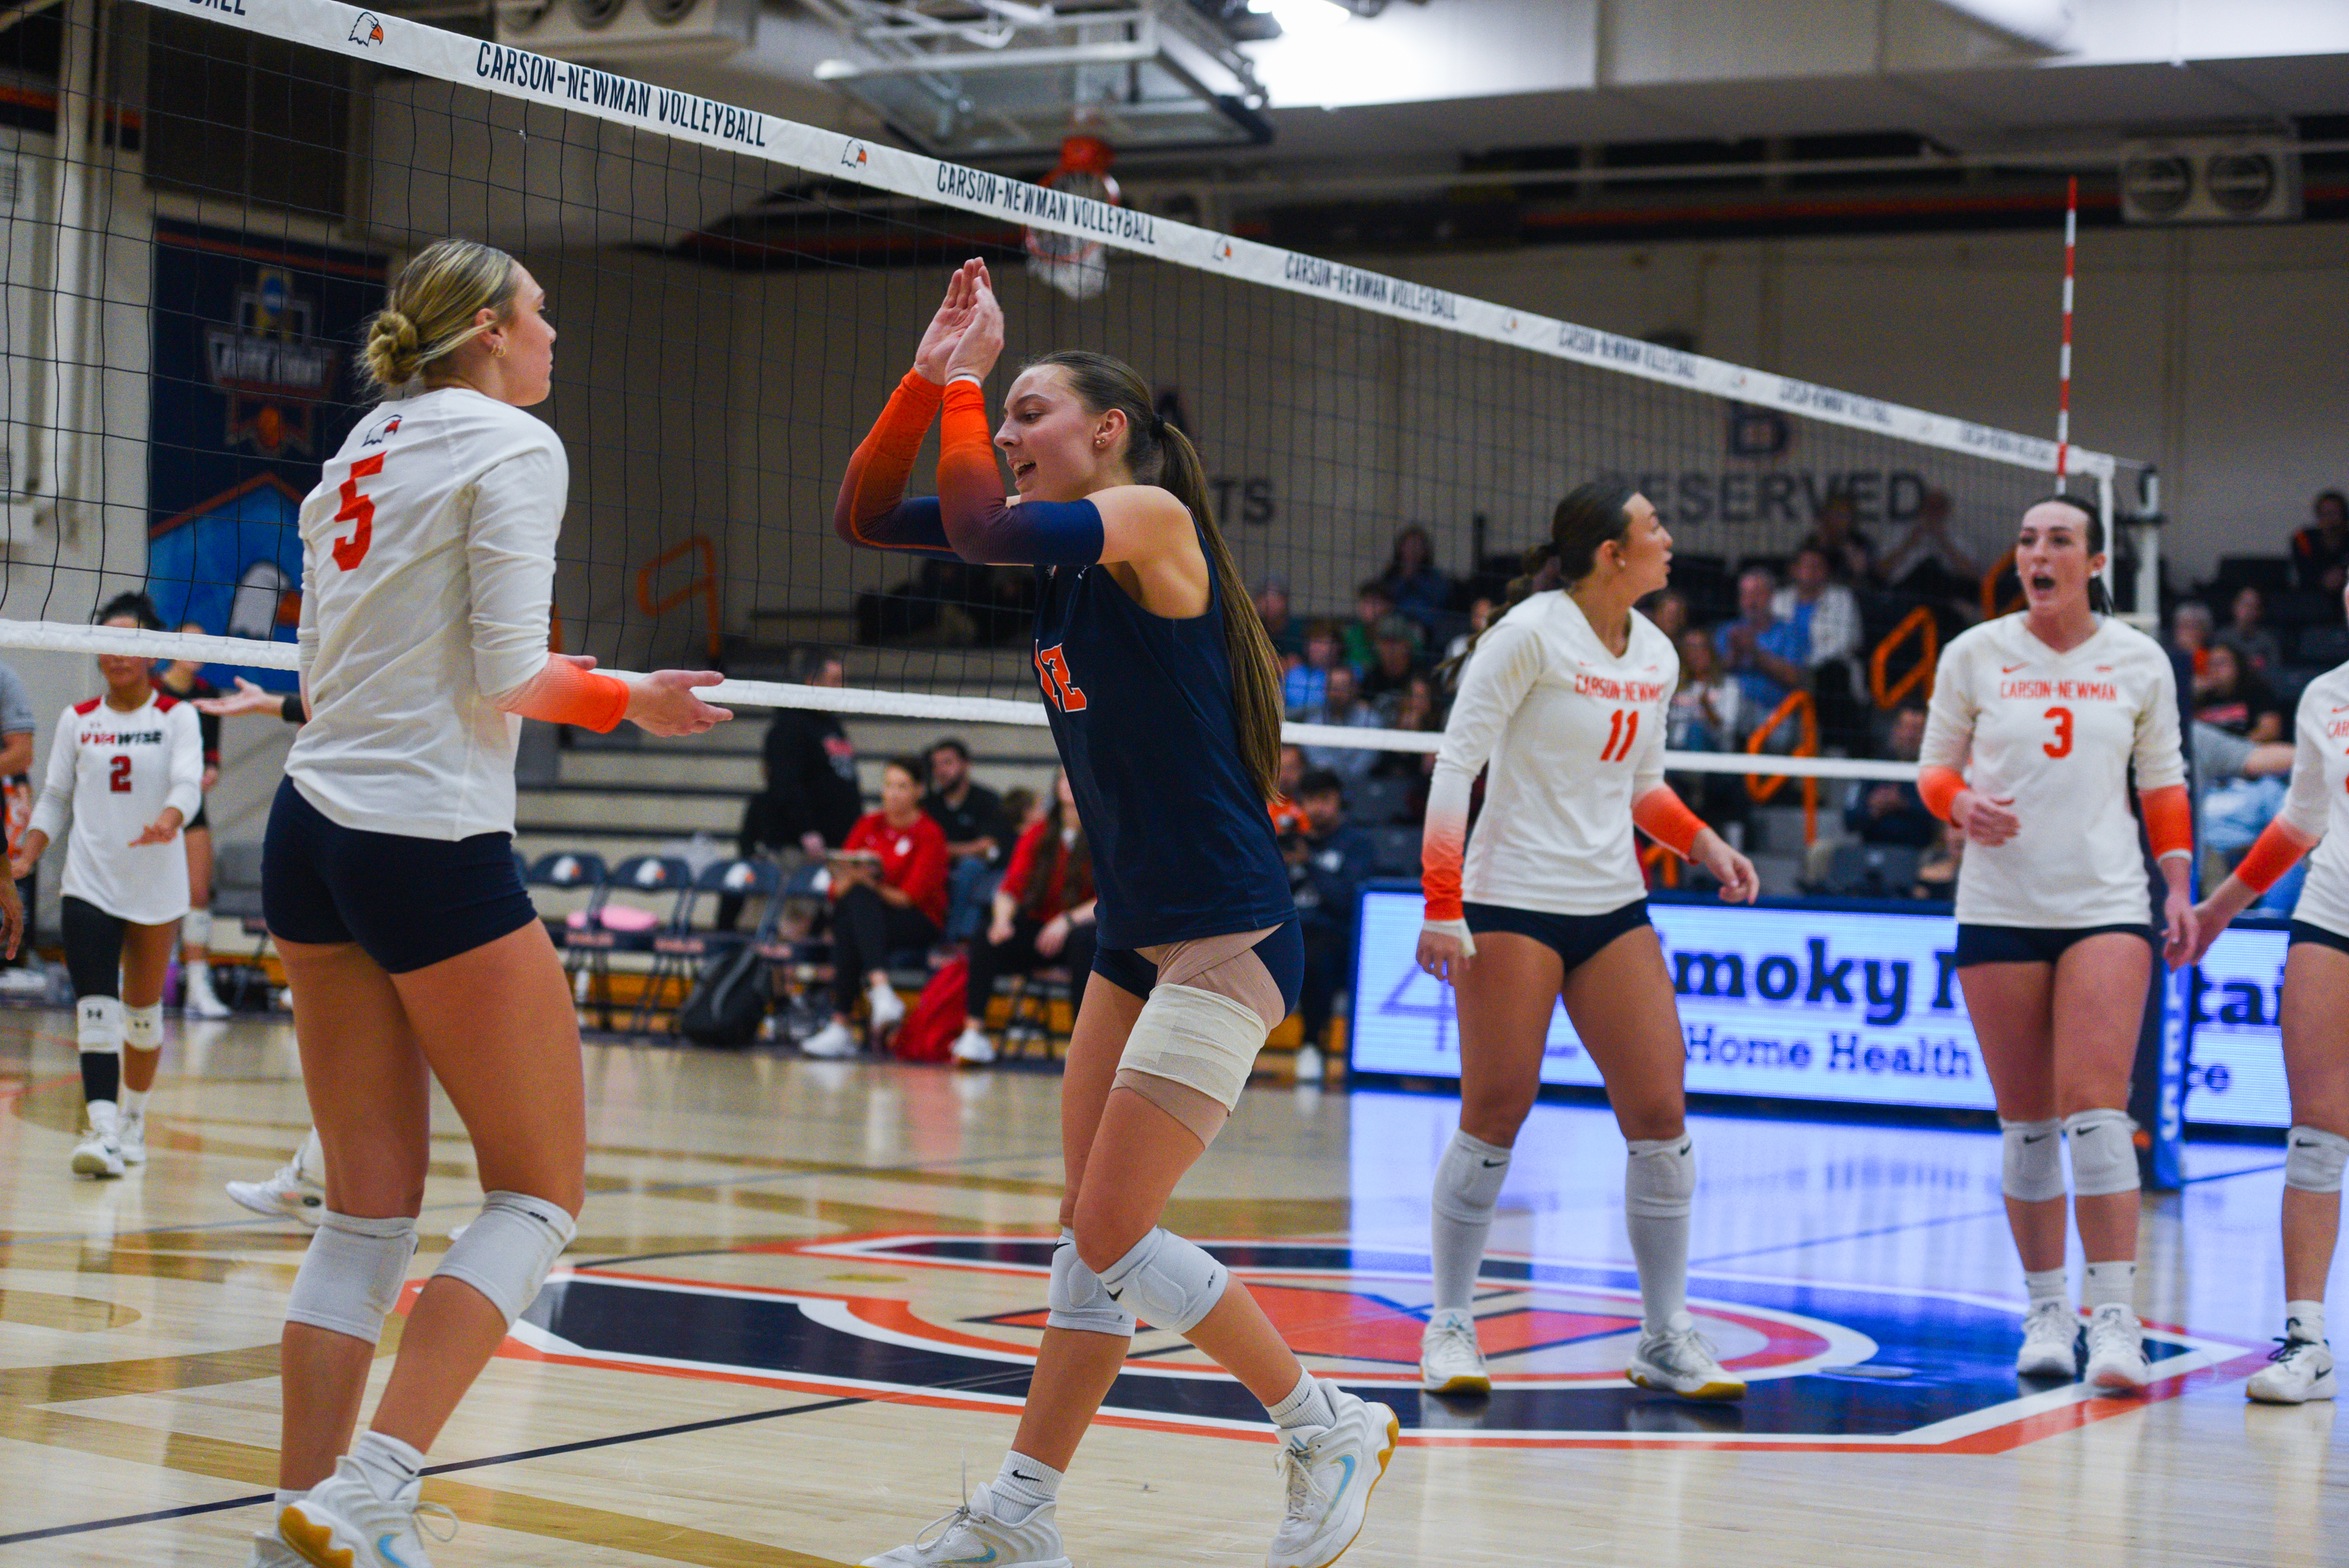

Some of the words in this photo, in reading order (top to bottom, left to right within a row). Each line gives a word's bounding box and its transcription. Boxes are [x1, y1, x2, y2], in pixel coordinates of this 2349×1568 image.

[476, 41, 651, 118] CARSON-NEWMAN
[658, 88, 766, 147] VOLLEYBALL
[936, 162, 1068, 226] CARSON-NEWMAN
[1072, 196, 1156, 245] VOLLEYBALL
[331, 450, 387, 572] 5
[2000, 679, 2118, 701] CARSON-NEWMAN
[1600, 708, 1639, 762] 11
[2043, 706, 2074, 759] 3
[109, 754, 132, 793] 2
[1657, 931, 1909, 1026] moky
[1687, 1026, 1813, 1066] Home
[1829, 1032, 1971, 1076] Health
